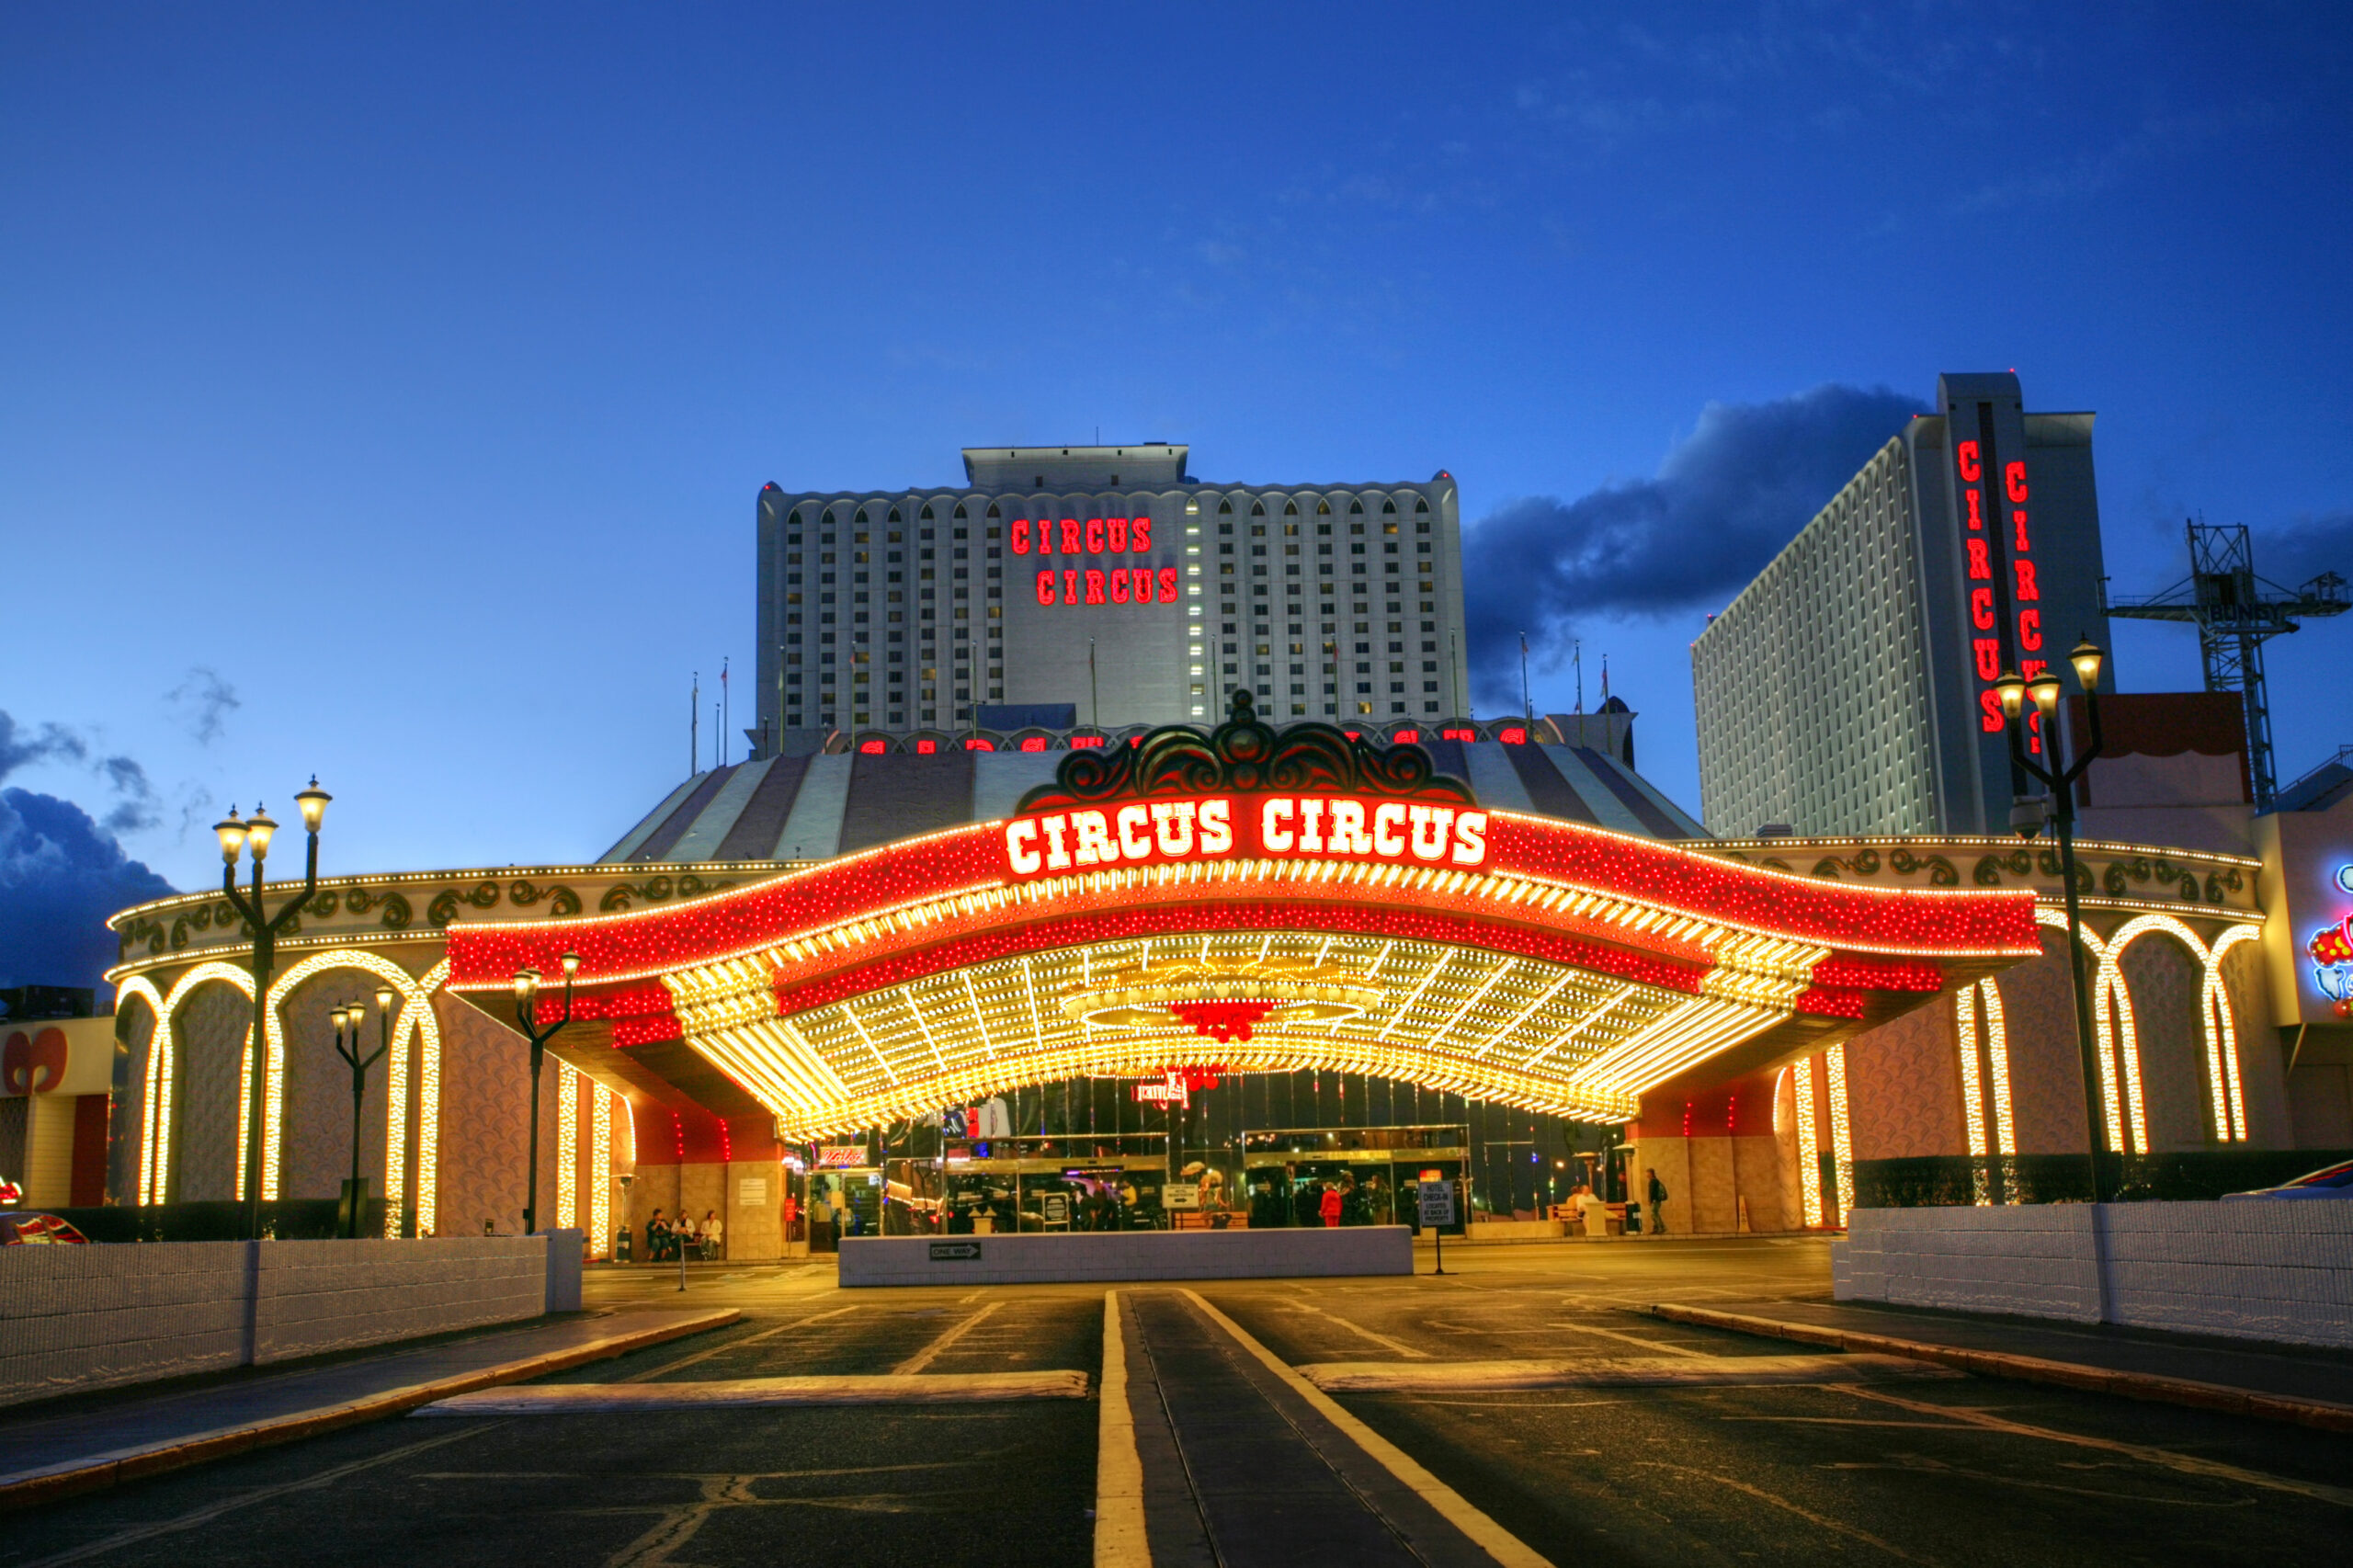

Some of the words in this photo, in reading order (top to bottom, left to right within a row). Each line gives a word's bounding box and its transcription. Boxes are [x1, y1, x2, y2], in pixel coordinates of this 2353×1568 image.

[1011, 517, 1152, 555] CIRCUS
[1036, 567, 1179, 607] CIRCUS
[1958, 440, 2005, 733] CIRCUS
[1006, 799, 1233, 875] CIRCUS
[1261, 798, 1488, 867] CIRCUS
[823, 1148, 864, 1164] Valet
